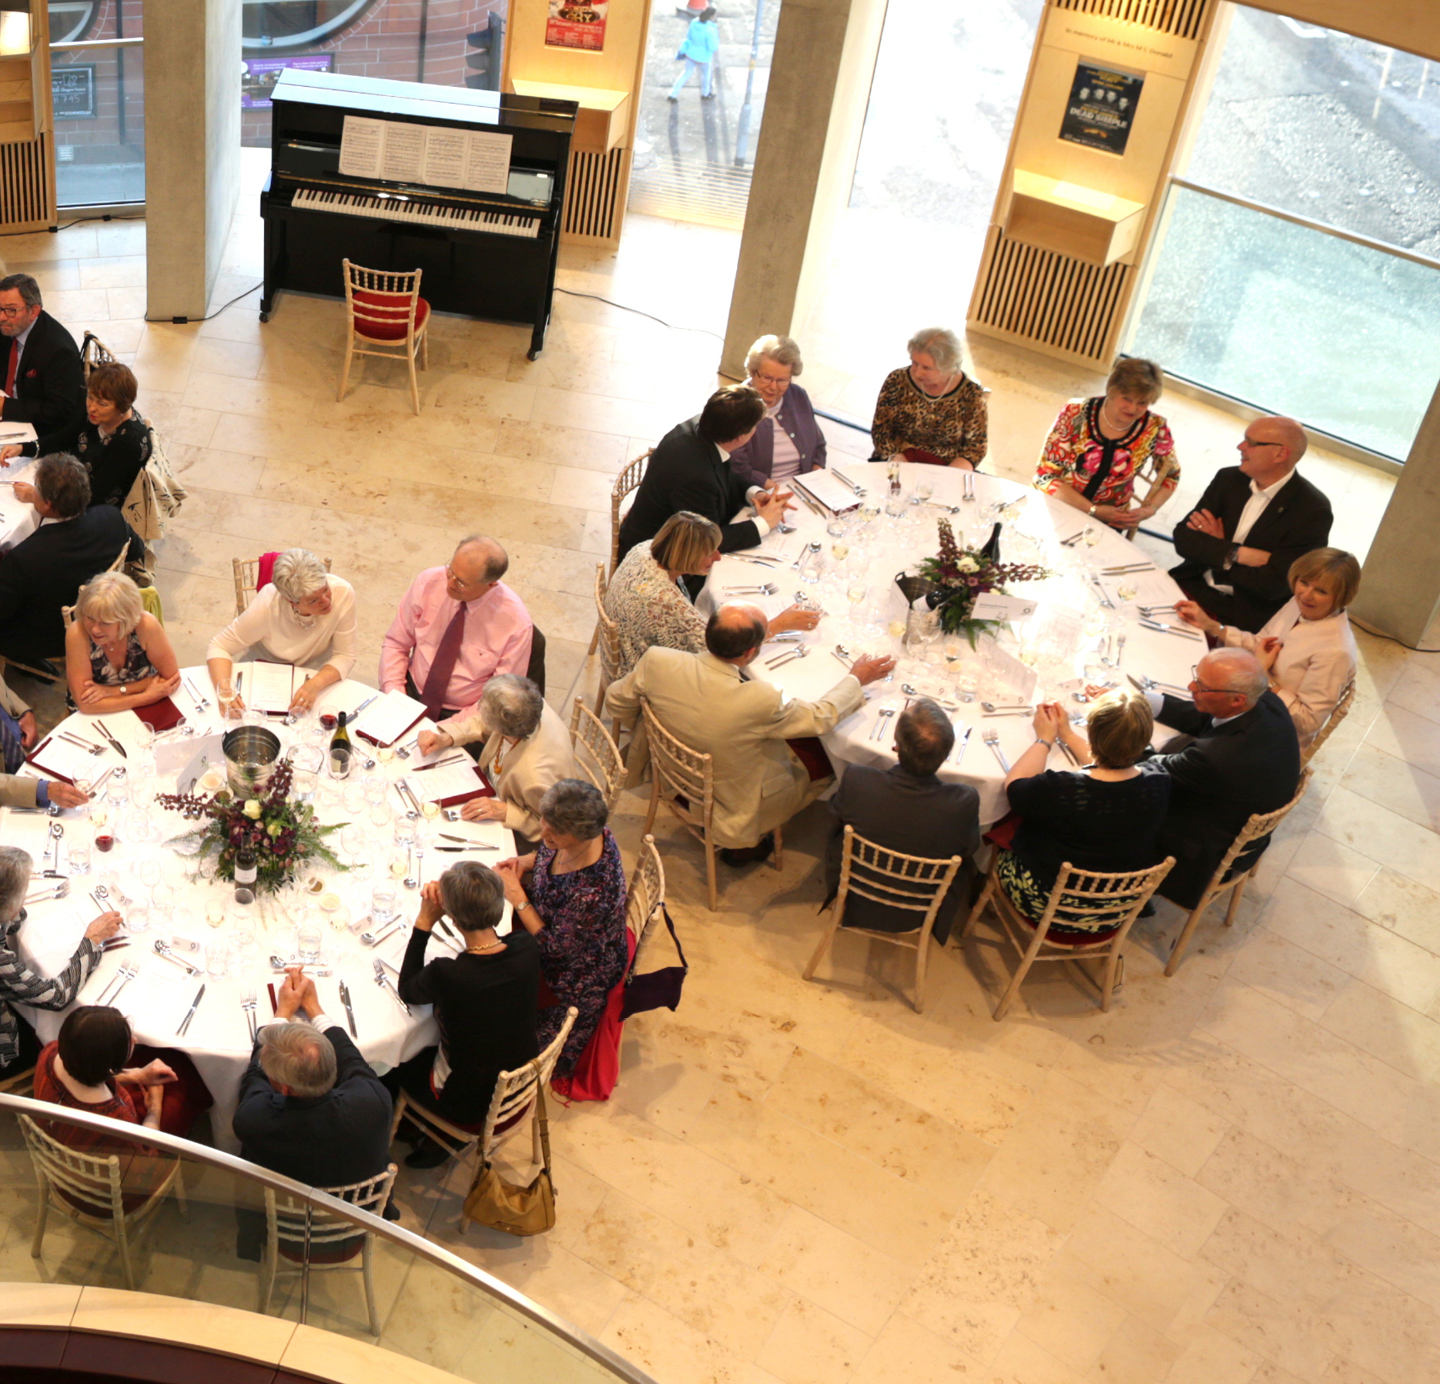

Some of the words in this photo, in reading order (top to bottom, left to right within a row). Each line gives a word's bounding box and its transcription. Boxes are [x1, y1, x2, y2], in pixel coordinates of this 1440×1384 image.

[1073, 30, 1098, 40] memory
[1070, 107, 1094, 119] DEAD
[1095, 112, 1128, 128] SIMPLE
